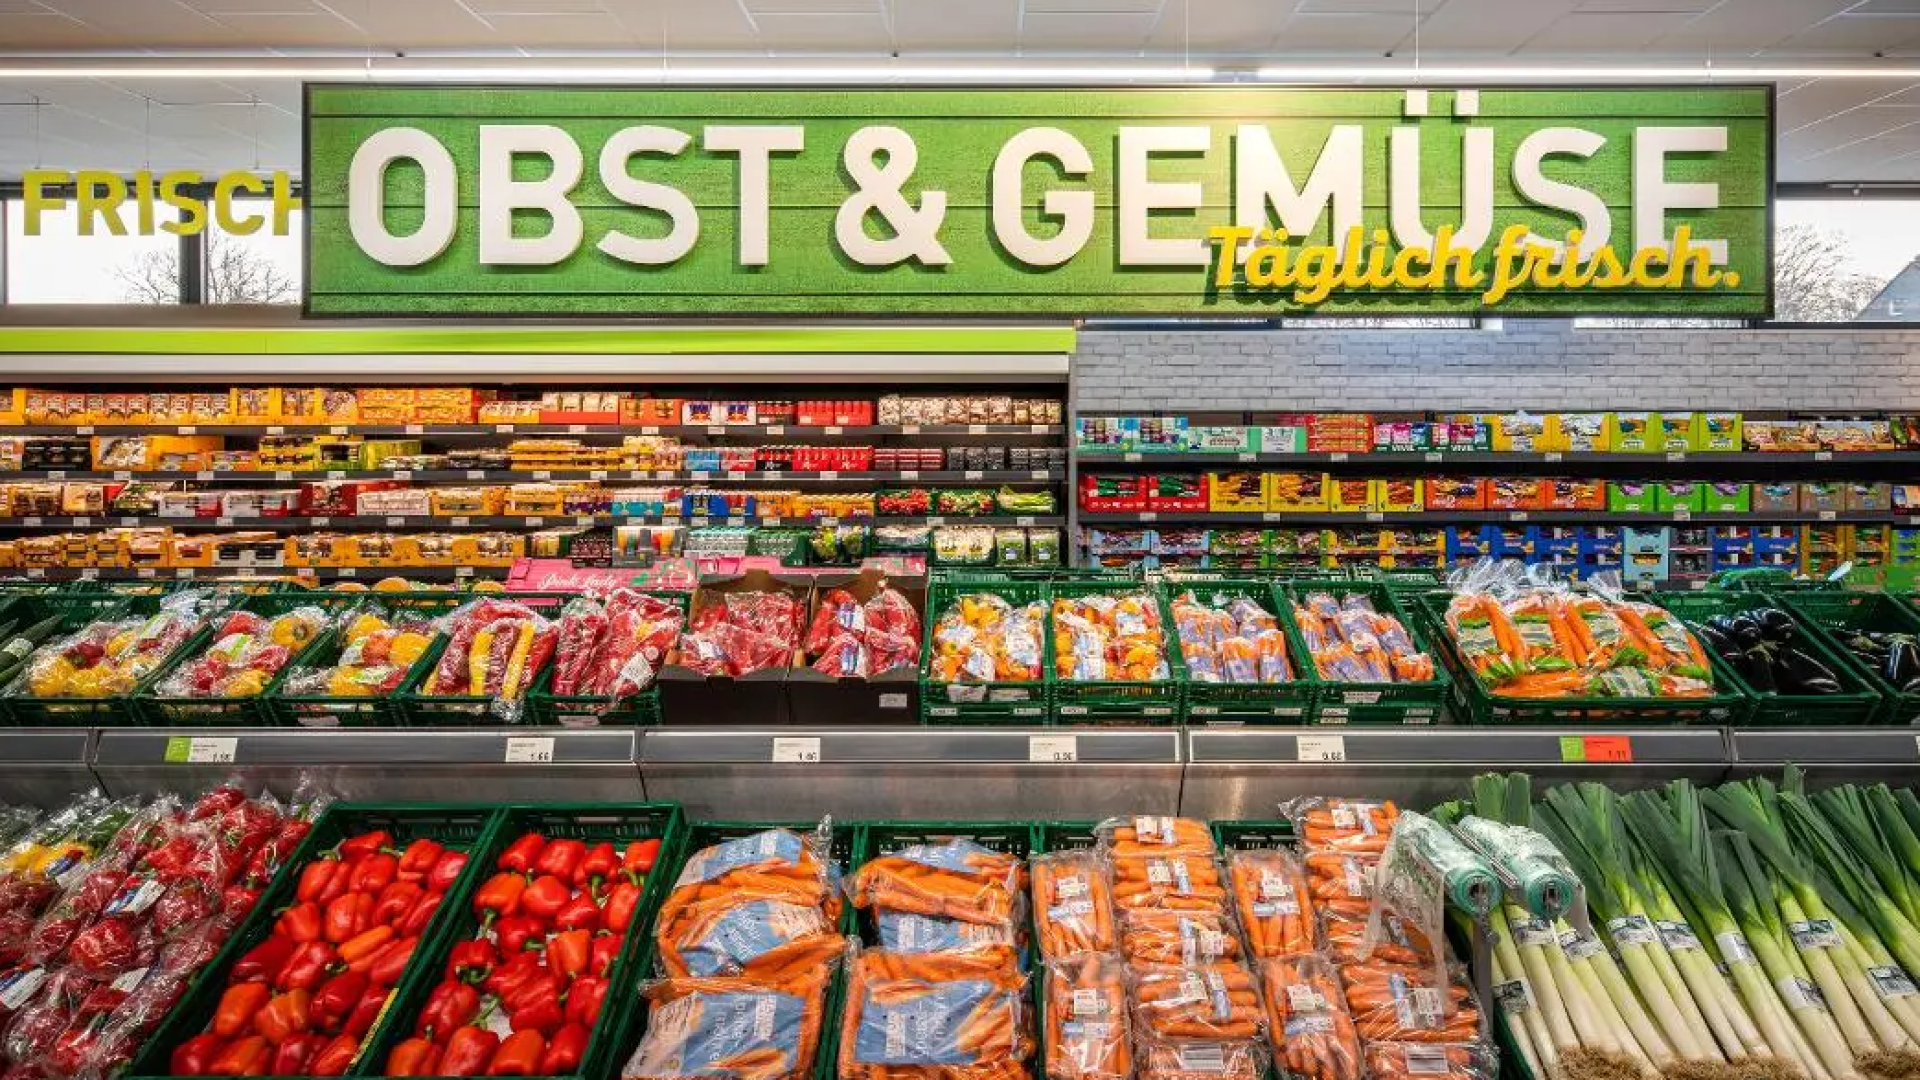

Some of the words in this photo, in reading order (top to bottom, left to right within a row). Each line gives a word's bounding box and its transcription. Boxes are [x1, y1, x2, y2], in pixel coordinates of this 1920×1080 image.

[348, 125, 804, 266] OBST
[835, 126, 954, 266] &
[992, 90, 1729, 266] GEMÜSE
[1207, 224, 1483, 305] Täglich
[1481, 224, 1741, 305] frisch.
